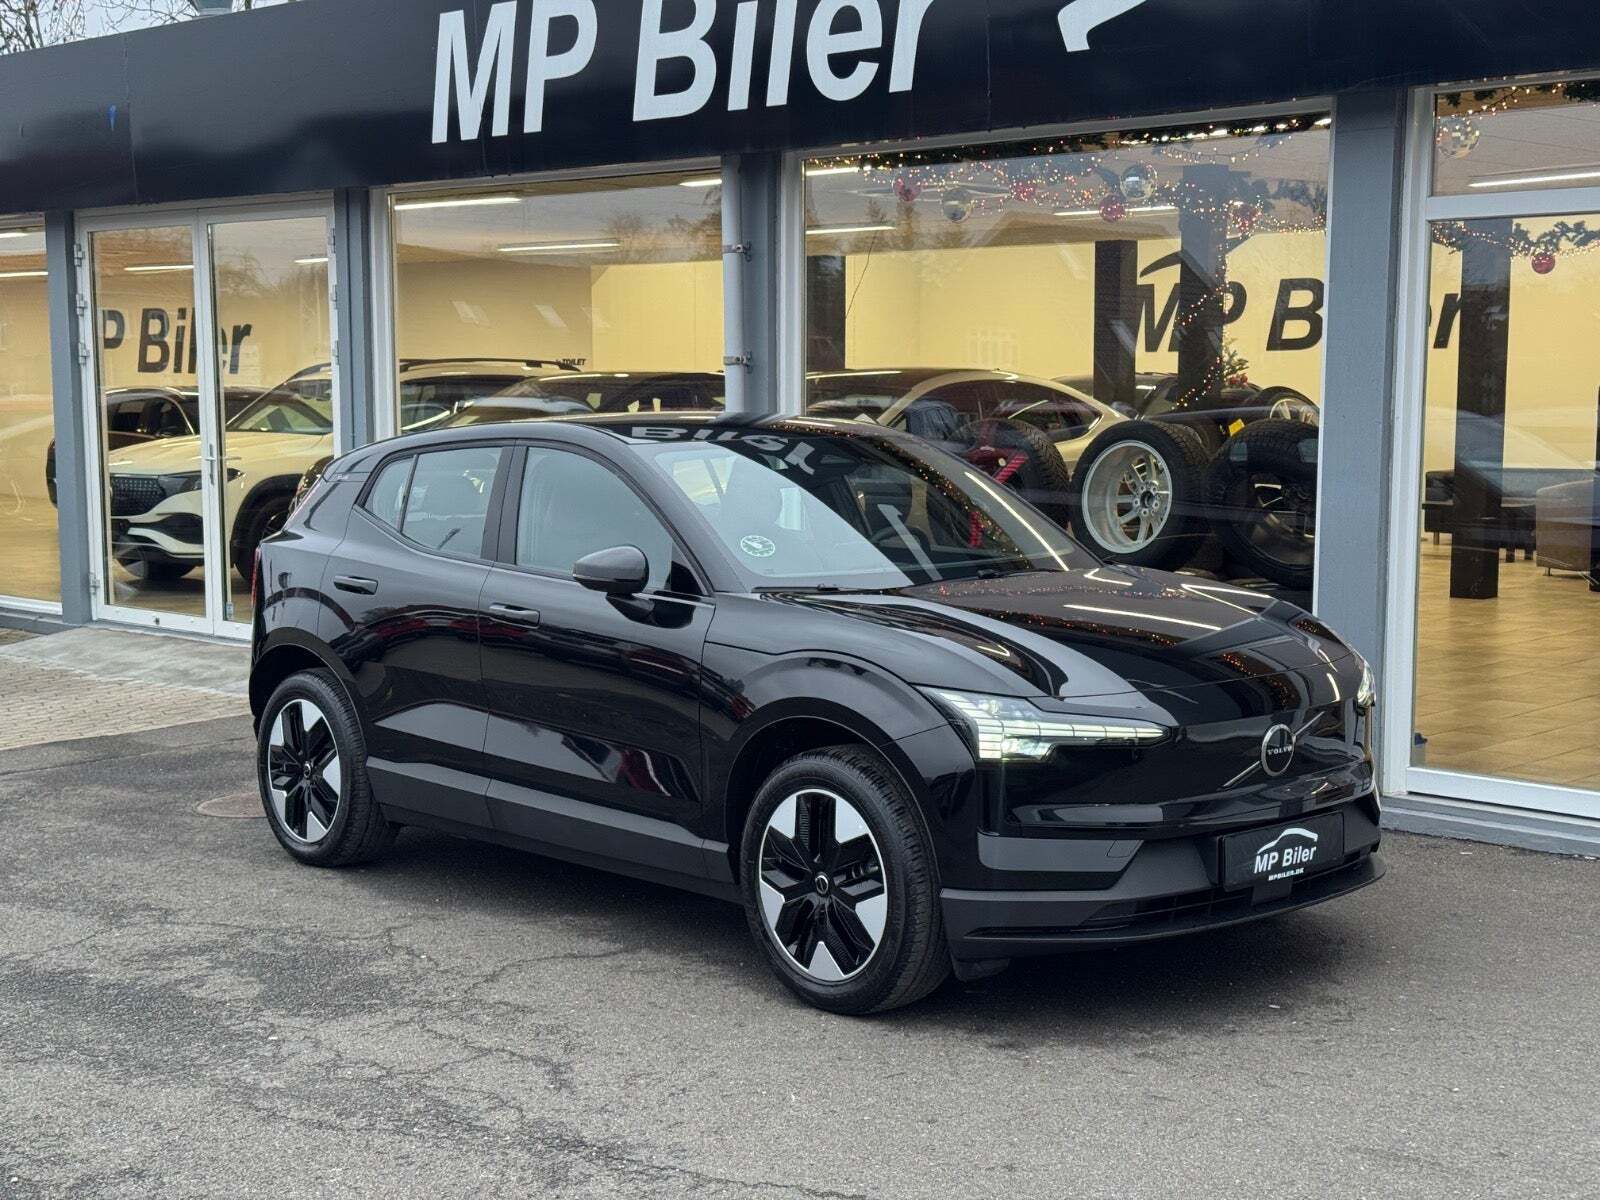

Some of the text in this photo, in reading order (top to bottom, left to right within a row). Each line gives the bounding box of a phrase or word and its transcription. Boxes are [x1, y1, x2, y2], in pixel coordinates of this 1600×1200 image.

[432, 0, 933, 143] MP Biler
[138, 308, 252, 374] Bilr
[1253, 845, 1317, 874] MP Biler
